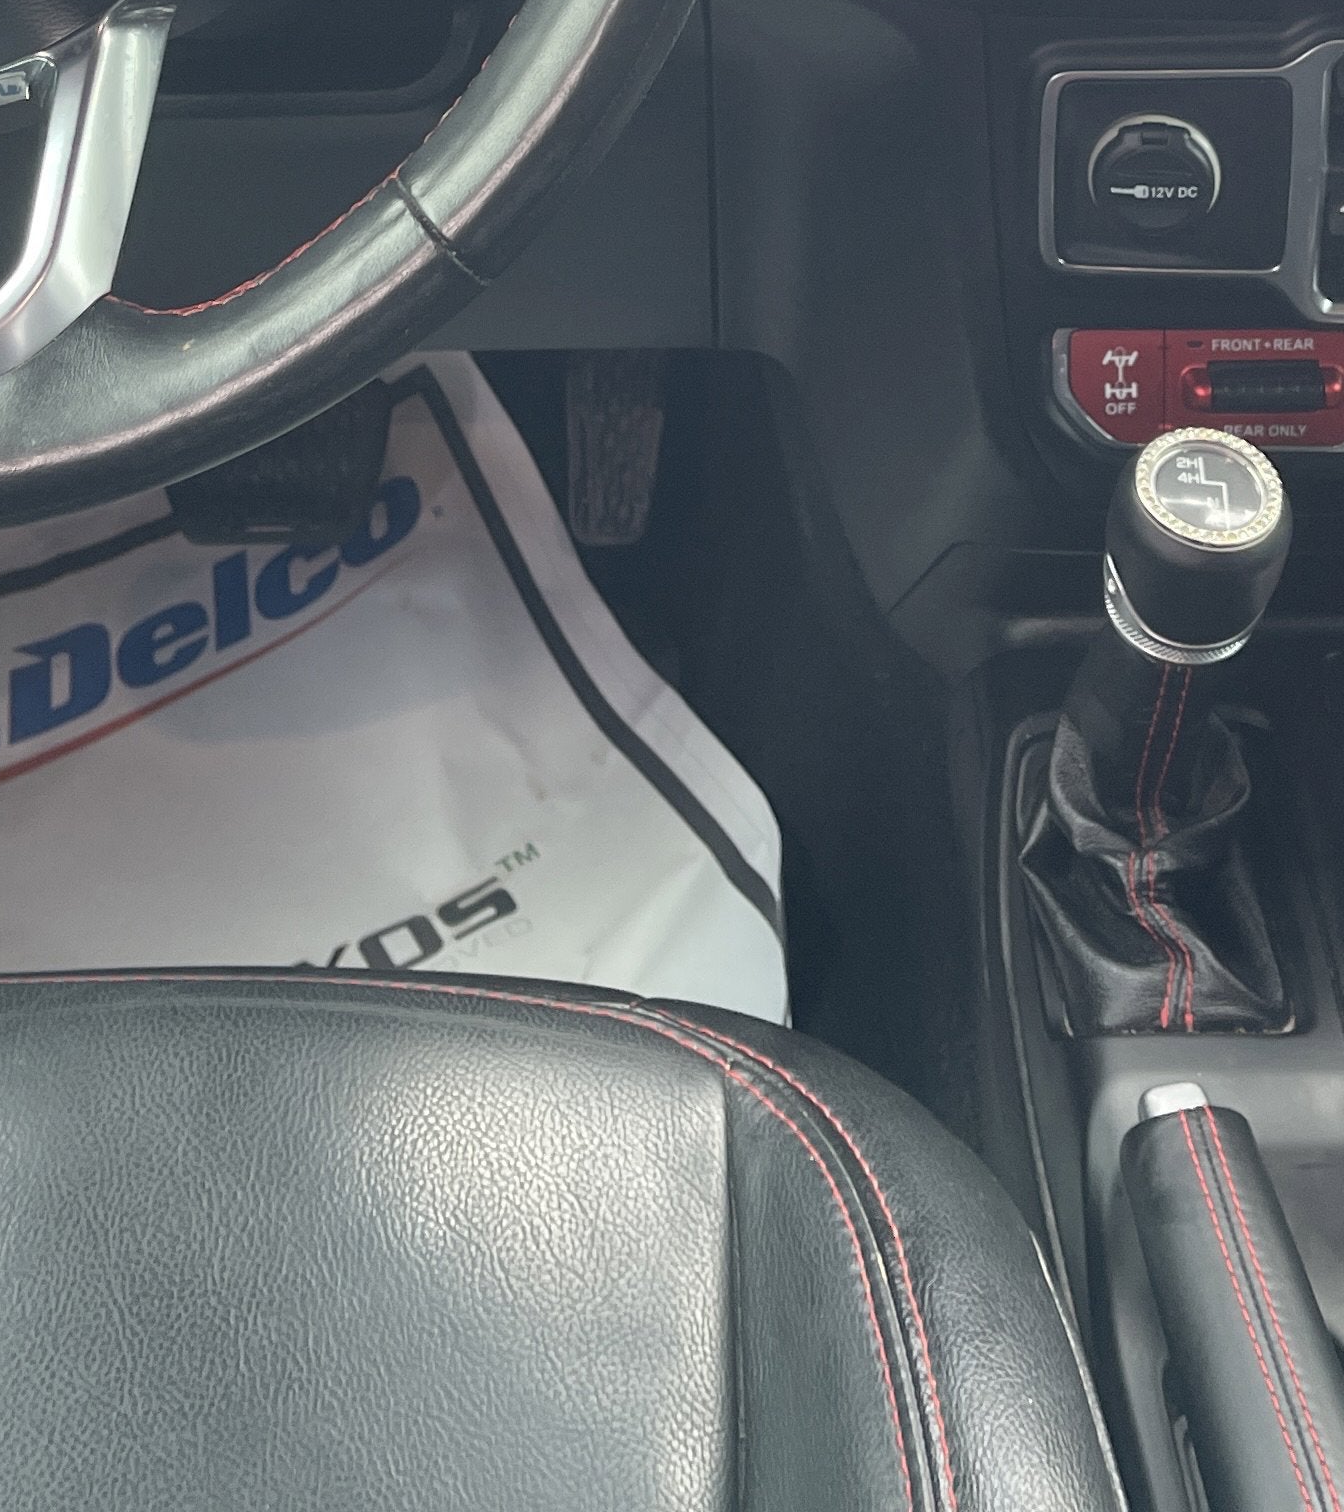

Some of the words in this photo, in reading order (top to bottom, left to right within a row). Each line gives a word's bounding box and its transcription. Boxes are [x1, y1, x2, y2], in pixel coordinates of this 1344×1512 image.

[1150, 186, 1175, 199] 12V
[1178, 186, 1198, 199] DC
[1211, 339, 1262, 351] FRONT
[1274, 338, 1314, 350] REAR
[1105, 402, 1137, 415] OFF
[1268, 424, 1306, 436] ONLY
[1176, 457, 1198, 469] 2H
[1177, 472, 1200, 484] 4H
